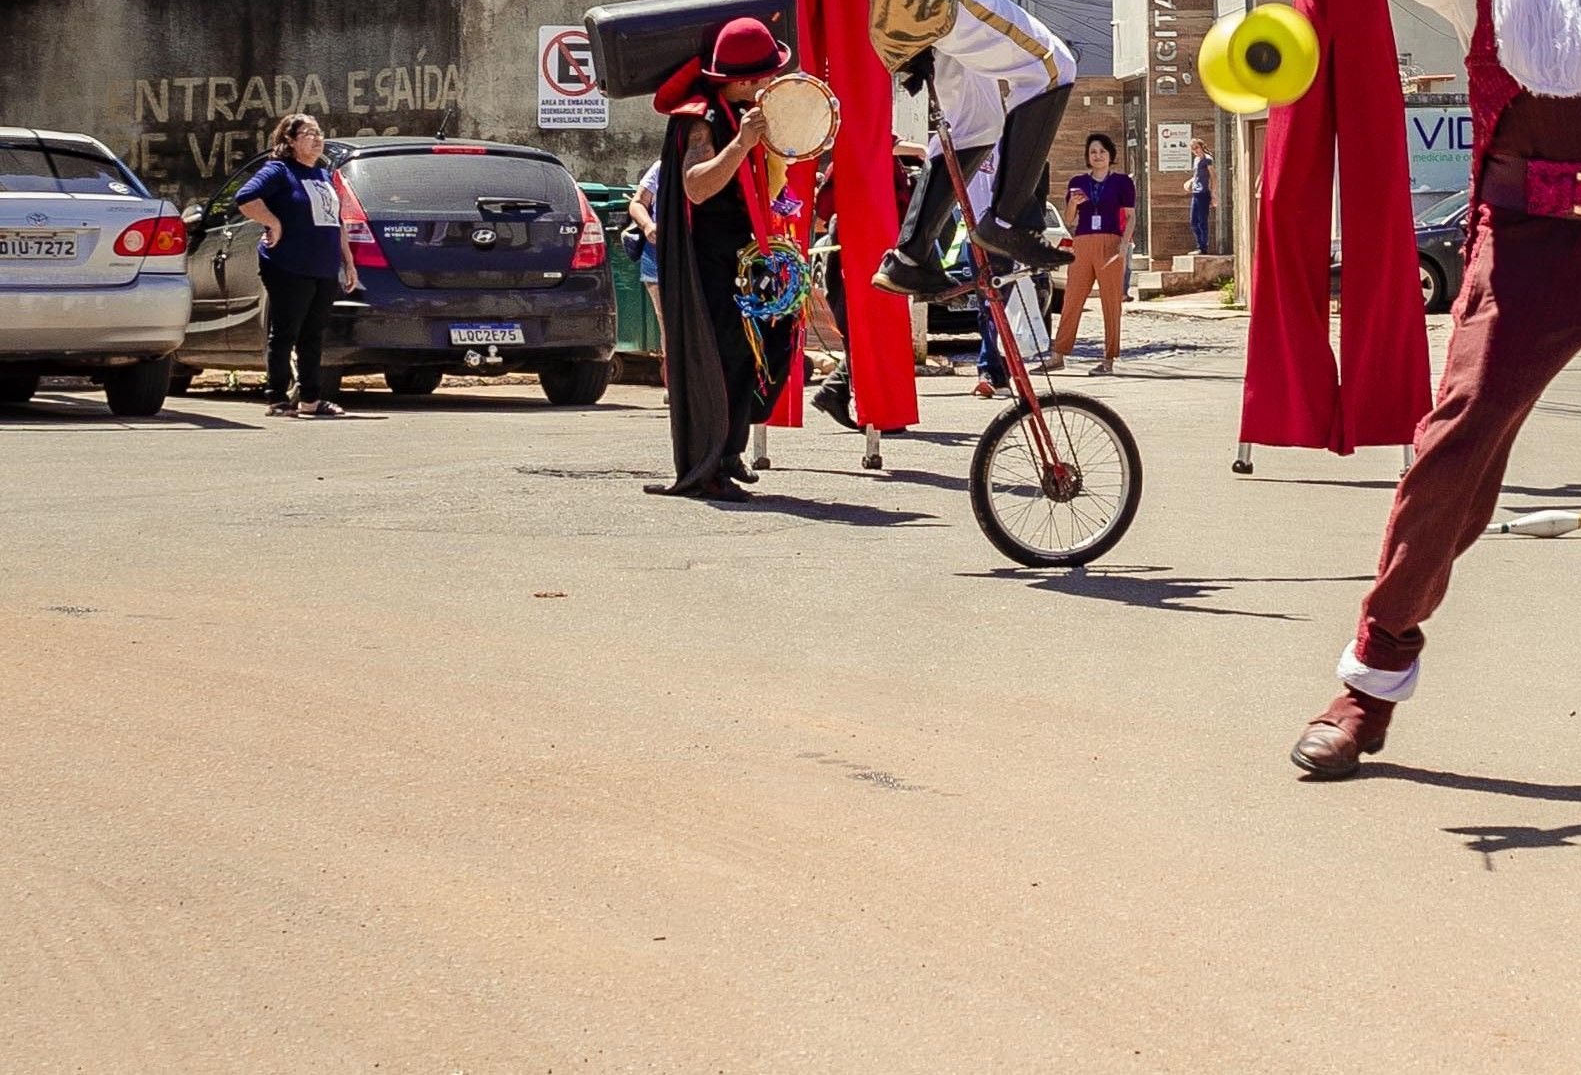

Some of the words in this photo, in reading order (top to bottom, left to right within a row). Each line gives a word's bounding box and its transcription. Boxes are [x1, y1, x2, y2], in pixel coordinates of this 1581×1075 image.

[567, 98, 599, 106] EMBARQUE
[1412, 153, 1453, 163] medicina
[1455, 154, 1461, 162] e
